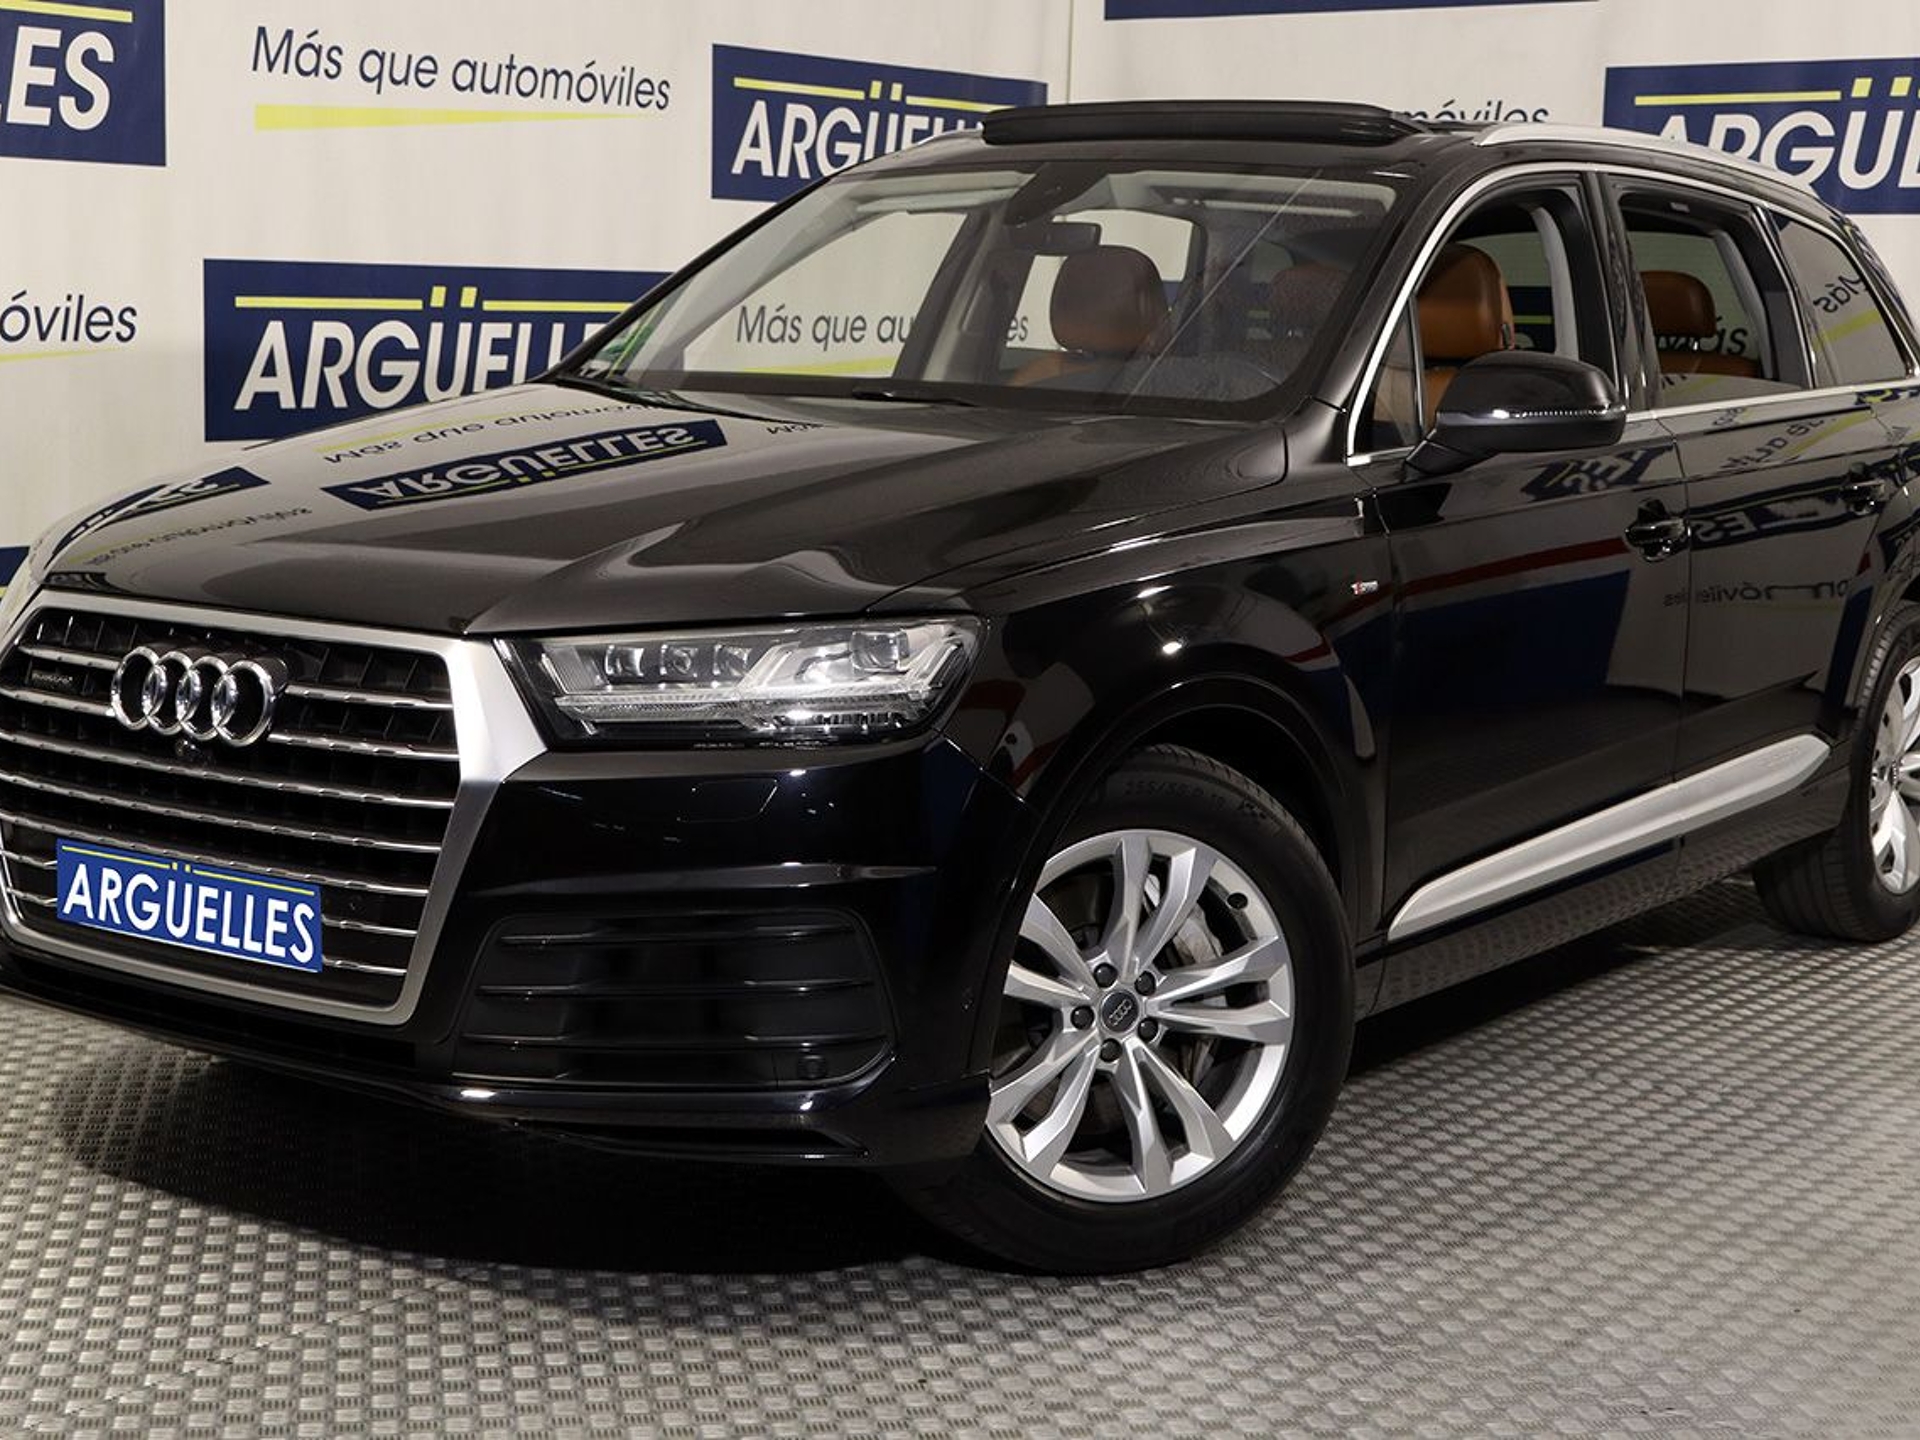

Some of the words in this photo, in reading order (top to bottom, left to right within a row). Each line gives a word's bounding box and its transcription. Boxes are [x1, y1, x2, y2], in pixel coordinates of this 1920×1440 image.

[252, 26, 343, 80] Más
[358, 45, 438, 95] que
[451, 53, 671, 110] automóviles
[736, 303, 802, 343] Más
[811, 314, 867, 351] que
[62, 861, 316, 964] ARGÜELLES
